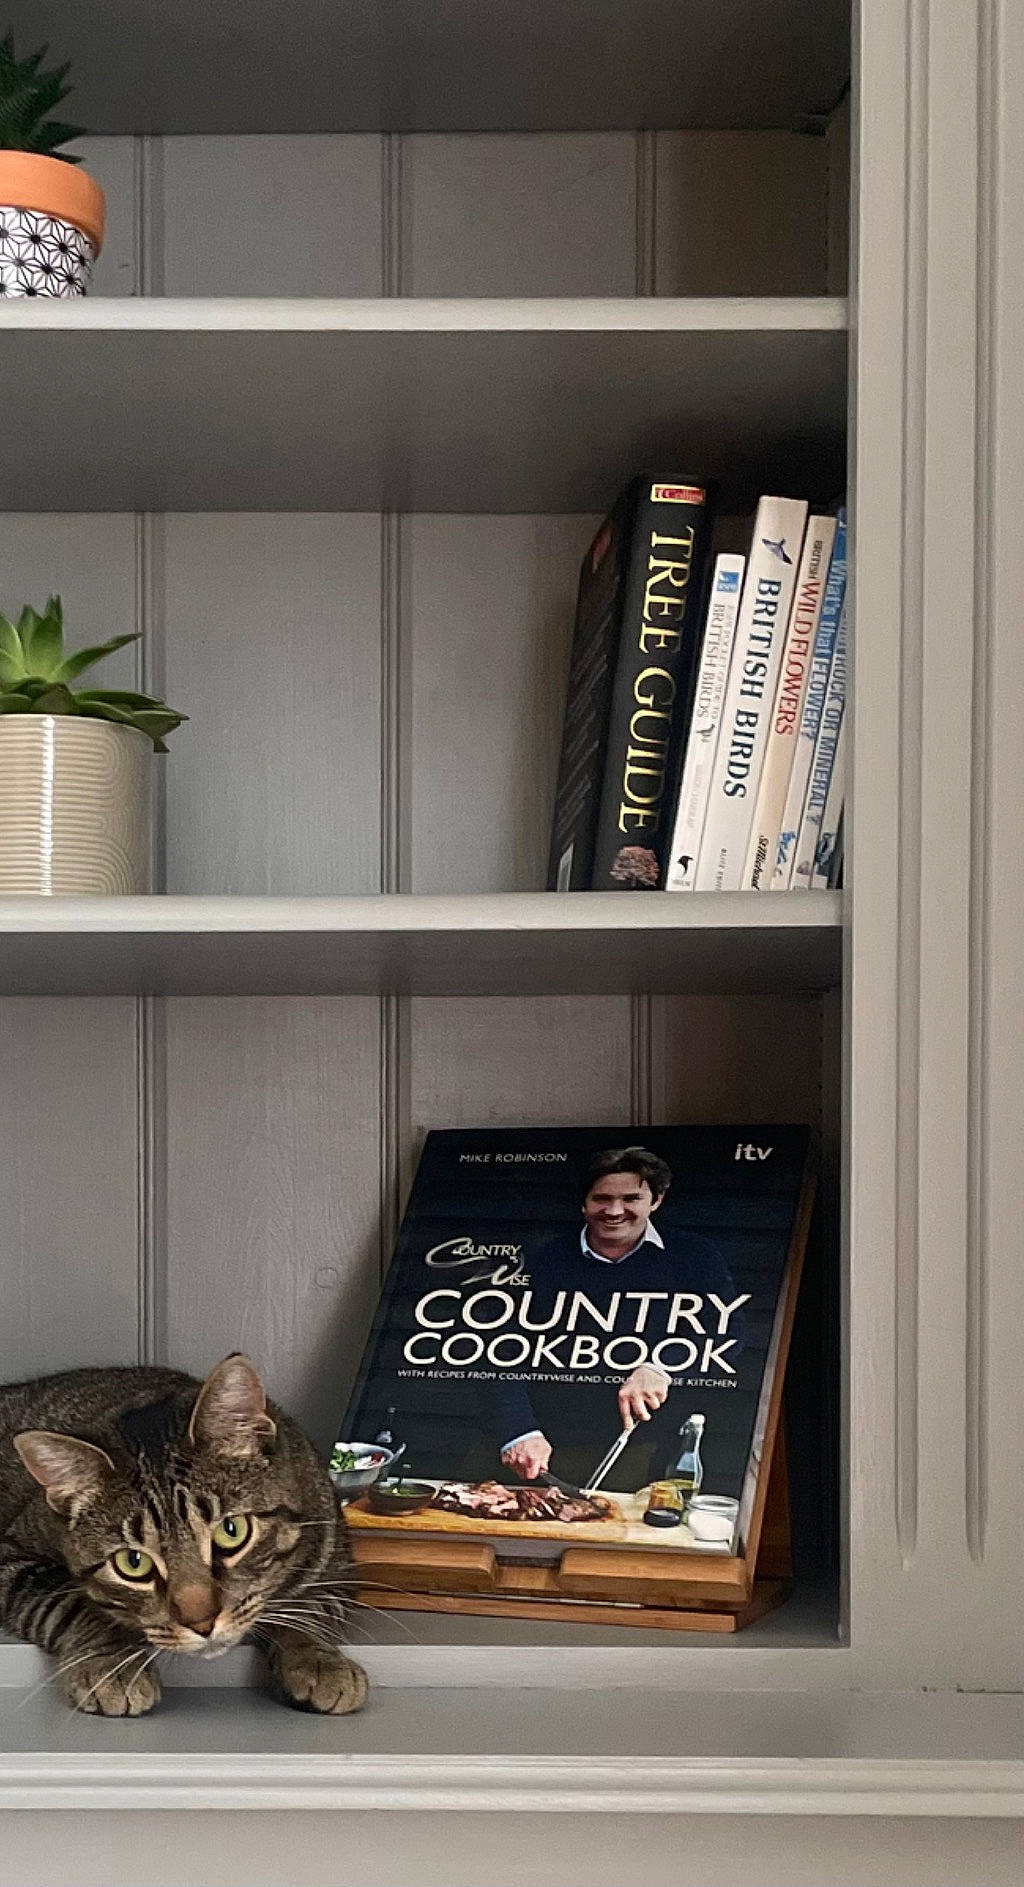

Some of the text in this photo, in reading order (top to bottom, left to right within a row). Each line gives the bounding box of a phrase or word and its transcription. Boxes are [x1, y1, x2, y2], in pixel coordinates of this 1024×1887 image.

[740, 578, 782, 699] BRITISH
[619, 525, 694, 833] TREE GUIDE
[723, 710, 759, 798] BIRDS
[459, 1153, 568, 1163] MIKE ROBINSON
[734, 1143, 774, 1162] itv
[414, 1289, 752, 1335] COUNTRY
[403, 1332, 739, 1374] COOKBOOK
[396, 1369, 425, 1379] WITH
[427, 1370, 466, 1380] RECIPES
[468, 1371, 496, 1381] FROM
[498, 1372, 576, 1383] COUNTRYWISE
[577, 1374, 602, 1384] AND
[687, 1378, 739, 1389] KITCHEN
